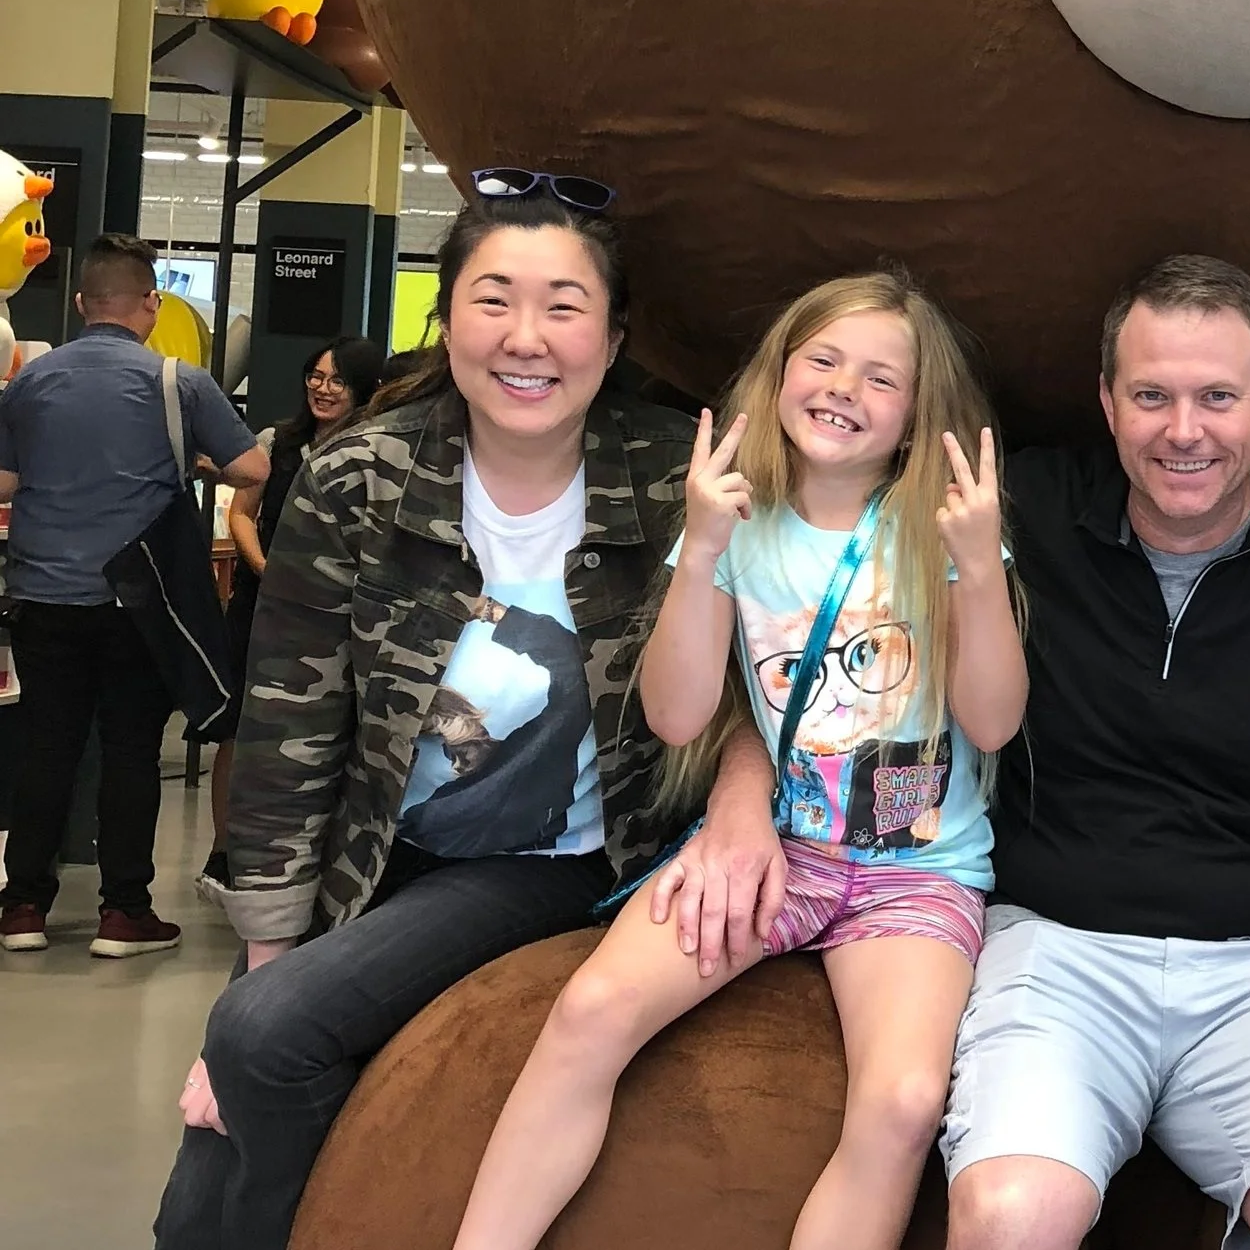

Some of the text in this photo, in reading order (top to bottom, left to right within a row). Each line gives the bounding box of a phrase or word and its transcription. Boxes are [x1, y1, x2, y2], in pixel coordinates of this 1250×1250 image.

[276, 251, 333, 265] Leonard
[275, 265, 316, 278] Street
[875, 785, 938, 811] GIRLS
